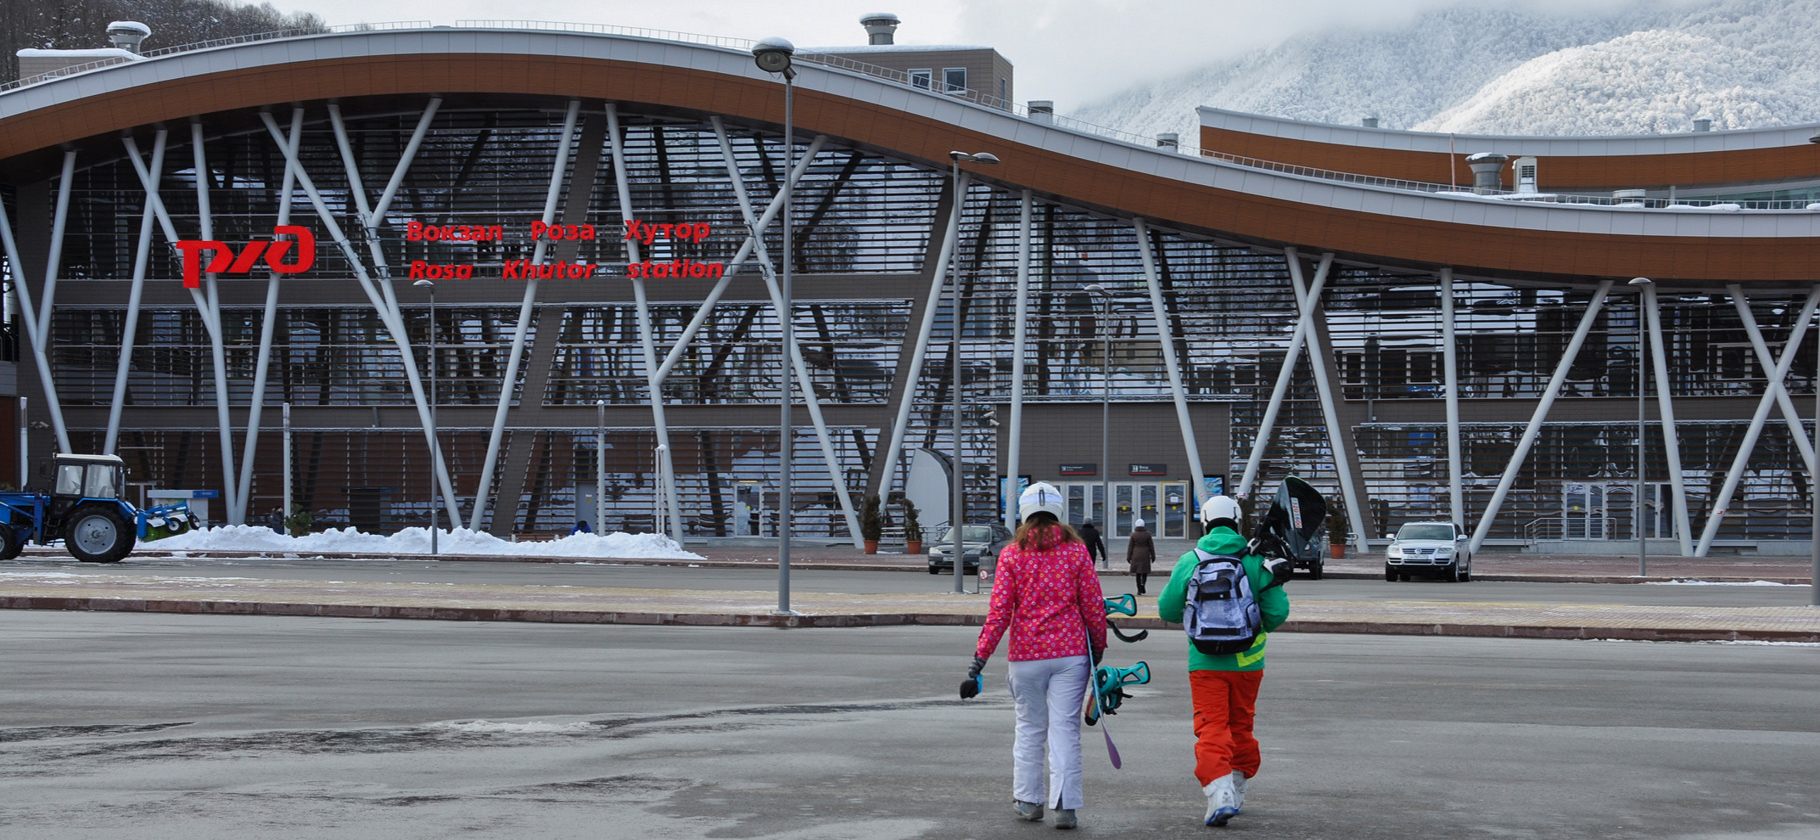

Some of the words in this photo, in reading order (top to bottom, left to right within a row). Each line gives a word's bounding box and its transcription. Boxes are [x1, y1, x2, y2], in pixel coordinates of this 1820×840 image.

[407, 221, 503, 241] Вокзал
[531, 220, 595, 241] Роза
[624, 219, 711, 245] Хутор
[408, 260, 474, 280] Rosa
[502, 259, 598, 280] Khutor
[626, 259, 724, 279] station
